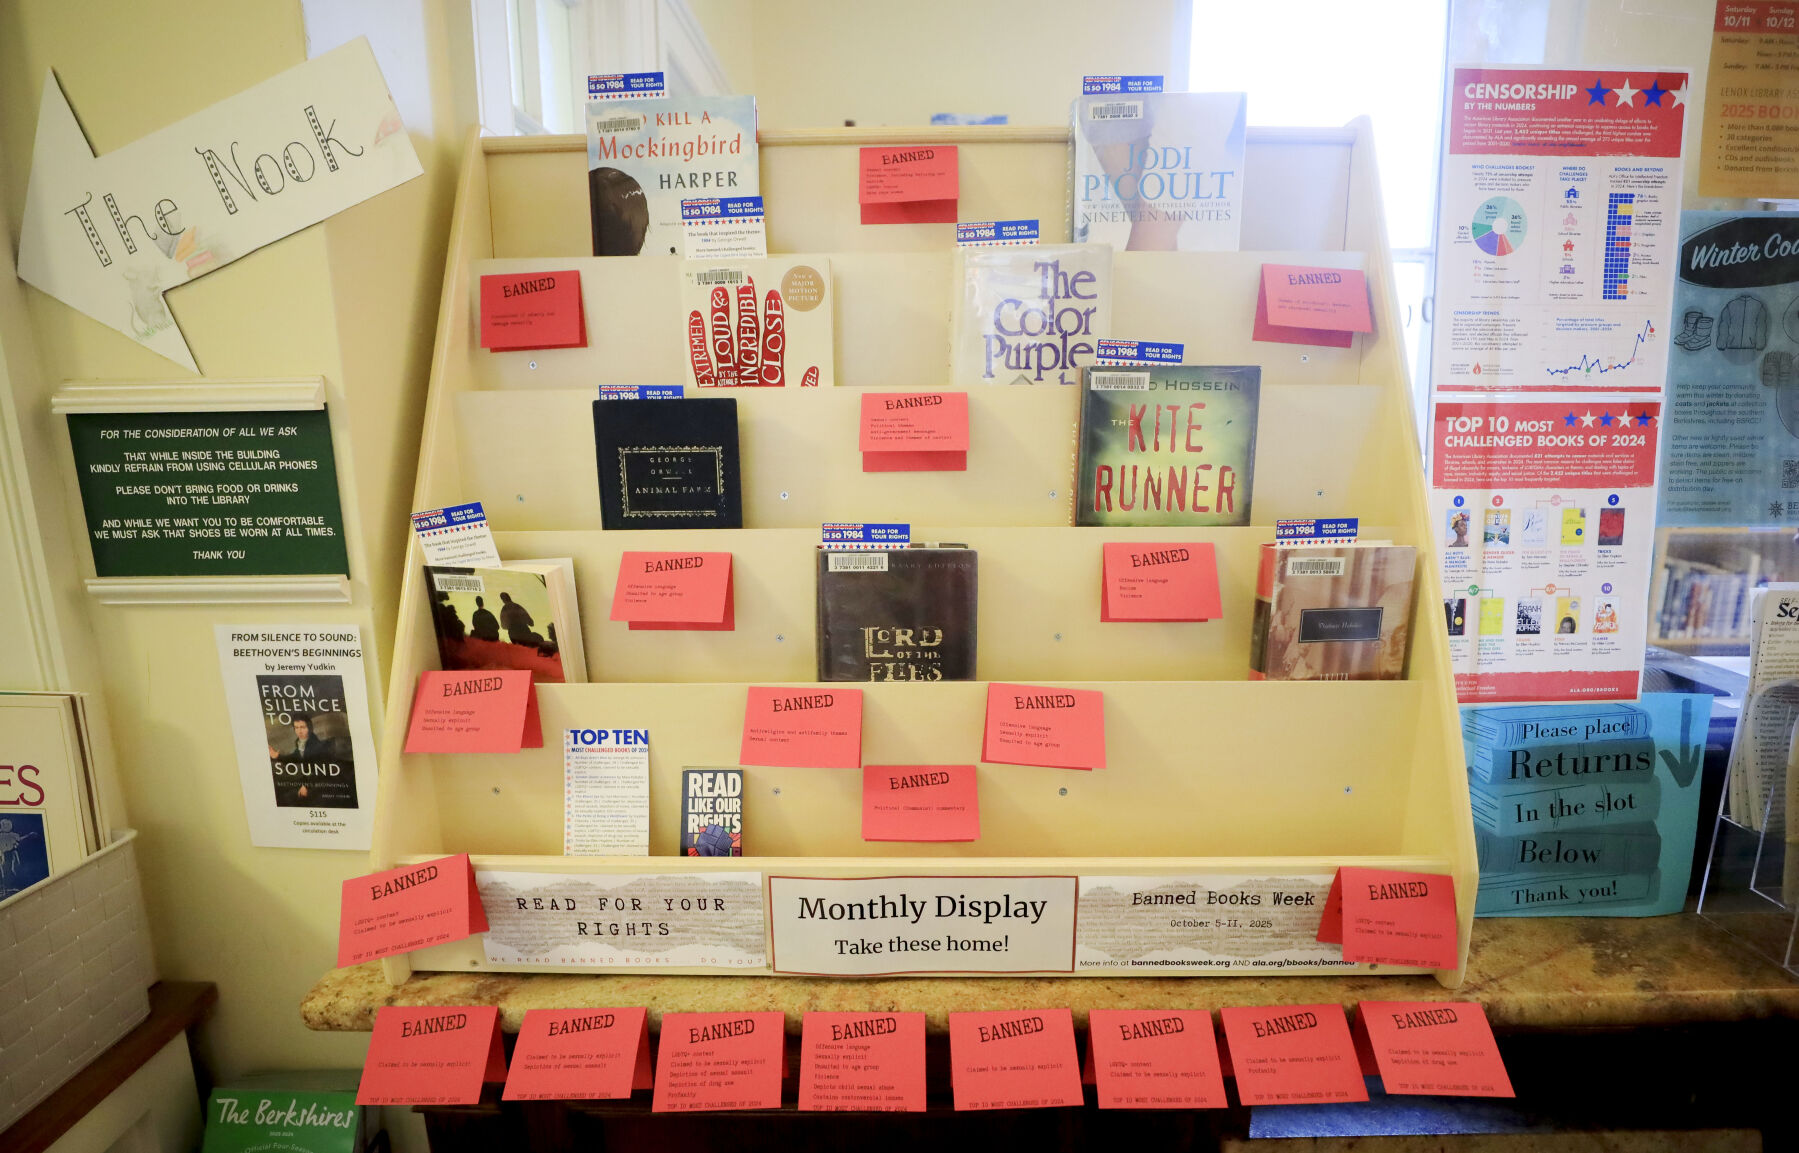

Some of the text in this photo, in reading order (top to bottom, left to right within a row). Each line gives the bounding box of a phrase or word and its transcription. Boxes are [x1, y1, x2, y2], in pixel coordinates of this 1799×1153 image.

[1464, 83, 1578, 100] CENSORSHIP
[1464, 102, 1475, 110] BY
[1478, 102, 1492, 110] THE
[656, 111, 711, 126] KILL A
[598, 134, 742, 162] Mockingbird
[1124, 144, 1192, 172] JODI
[64, 106, 364, 268] The Nook
[660, 171, 738, 190] HARPER
[1082, 172, 1234, 201] PICOULT
[1082, 210, 1231, 224] NINETEEN MINUTES
[1691, 243, 1760, 271] Winter
[502, 278, 556, 298] BANNED
[1034, 260, 1098, 300] The
[994, 297, 1096, 336] Color
[712, 290, 734, 369] LOUD &
[691, 314, 714, 388] EXTREMELY
[761, 299, 783, 384] CLOSE
[982, 330, 1094, 381] Purple
[885, 396, 942, 410] BANNED
[100, 426, 298, 439] FOR THE CONSIDERATION OF ALL WE ASK
[1128, 402, 1206, 453] KITE
[1446, 416, 1554, 432] TOP 10 MOST
[1444, 434, 1646, 447] CHALLENGED BOOKS OF 2024
[124, 450, 280, 462] THAT WHILE INSIDE THE BUILDING
[90, 460, 318, 473] KINDLY REFRAIN FROM USING CELLULAR PHONES
[116, 483, 298, 494] PLEASE DON'T BRING FOOD OR DRINKS
[1094, 464, 1236, 513] RUNNER
[167, 496, 250, 505] INTO THE LIBRARY
[102, 516, 324, 528] AND WHILE WE WANT YOU TO BE COMFORTABLE
[94, 527, 336, 539] WE MUST ASK THAT SHOES BE WORN AT ALL TIMES.
[193, 550, 246, 560] THANK YOU
[645, 556, 704, 572] BANNED
[1131, 548, 1190, 568] BANNED
[232, 634, 356, 642] FROM SILENCE TO SOUND:
[860, 626, 942, 658] LORD
[234, 648, 362, 658] BEETHOVEN'S BEGINNINGS
[265, 663, 275, 672] by
[277, 664, 306, 672] Jeremy
[262, 685, 315, 698] FROM
[443, 677, 502, 697] BANNED
[264, 698, 341, 712] SILENCE
[773, 694, 834, 712] BANNED
[1014, 694, 1076, 710] BANNED
[266, 712, 292, 726] TO
[570, 730, 648, 745] TOP TEN
[1523, 718, 1631, 742] Please place
[275, 763, 340, 776] SOUND
[1508, 750, 1651, 780] Returns
[688, 772, 742, 798] READ
[889, 772, 950, 790] BANNED
[310, 810, 327, 818] $115
[688, 798, 740, 812] LIKE OUR
[1516, 792, 1637, 824] In the slot
[688, 814, 742, 834] RIGHTS
[1518, 839, 1602, 864] Below
[371, 866, 438, 900] BANNED
[1368, 882, 1428, 900] BANNED
[1512, 881, 1617, 904] Thank you!
[516, 898, 726, 910] READ FOR YOUR
[1132, 891, 1315, 906] Banned Books Week
[798, 894, 1047, 924] Monthly Display
[578, 922, 670, 936] RIGHTS
[1170, 919, 1210, 928] October
[1250, 919, 1272, 928] 2025
[835, 935, 1009, 955] Take these home!
[1131, 958, 1230, 968] bannedbooksweek.org
[401, 1014, 466, 1038] BANNED
[548, 1014, 614, 1036] BANNED
[832, 1017, 897, 1040] BANNED
[1120, 1017, 1184, 1040] BANNED
[1252, 1012, 1318, 1038] BANNED
[1392, 1008, 1458, 1030] BANNED
[689, 1019, 754, 1044] BANNED
[978, 1016, 1044, 1042] BANNED
[216, 1098, 354, 1128] The Berkshires
